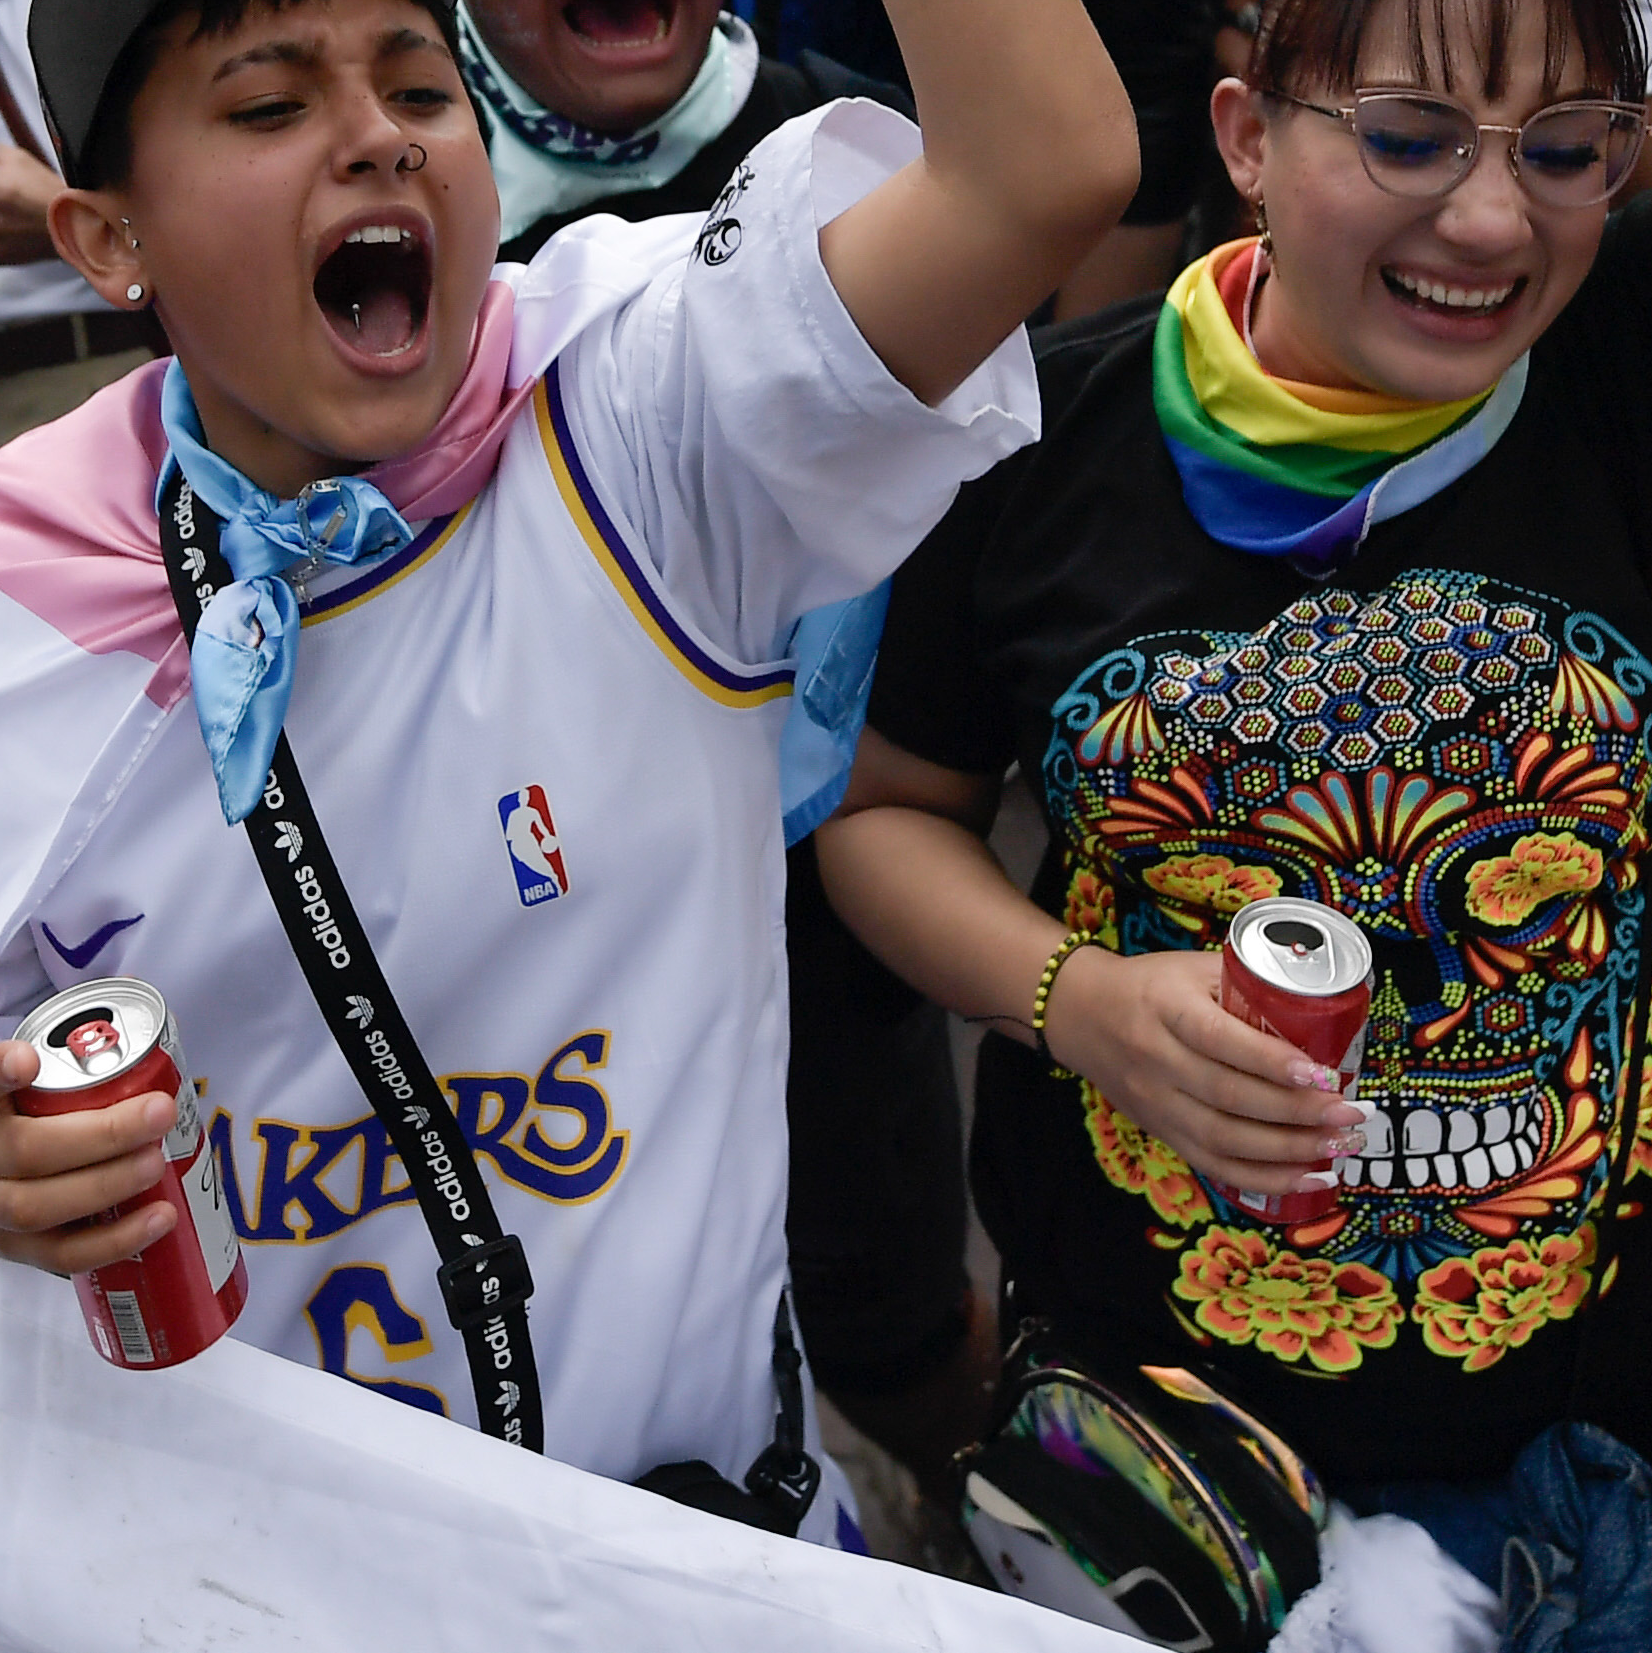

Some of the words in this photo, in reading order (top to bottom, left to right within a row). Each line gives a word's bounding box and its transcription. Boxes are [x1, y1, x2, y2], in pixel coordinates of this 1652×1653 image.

[294, 864, 351, 970] adidas
[523, 882, 556, 903] NBA
[364, 1029, 415, 1101] adidas
[195, 1027, 631, 1246] AKERS
[420, 1129, 471, 1222] adidas
[481, 1275, 513, 1371] adias
